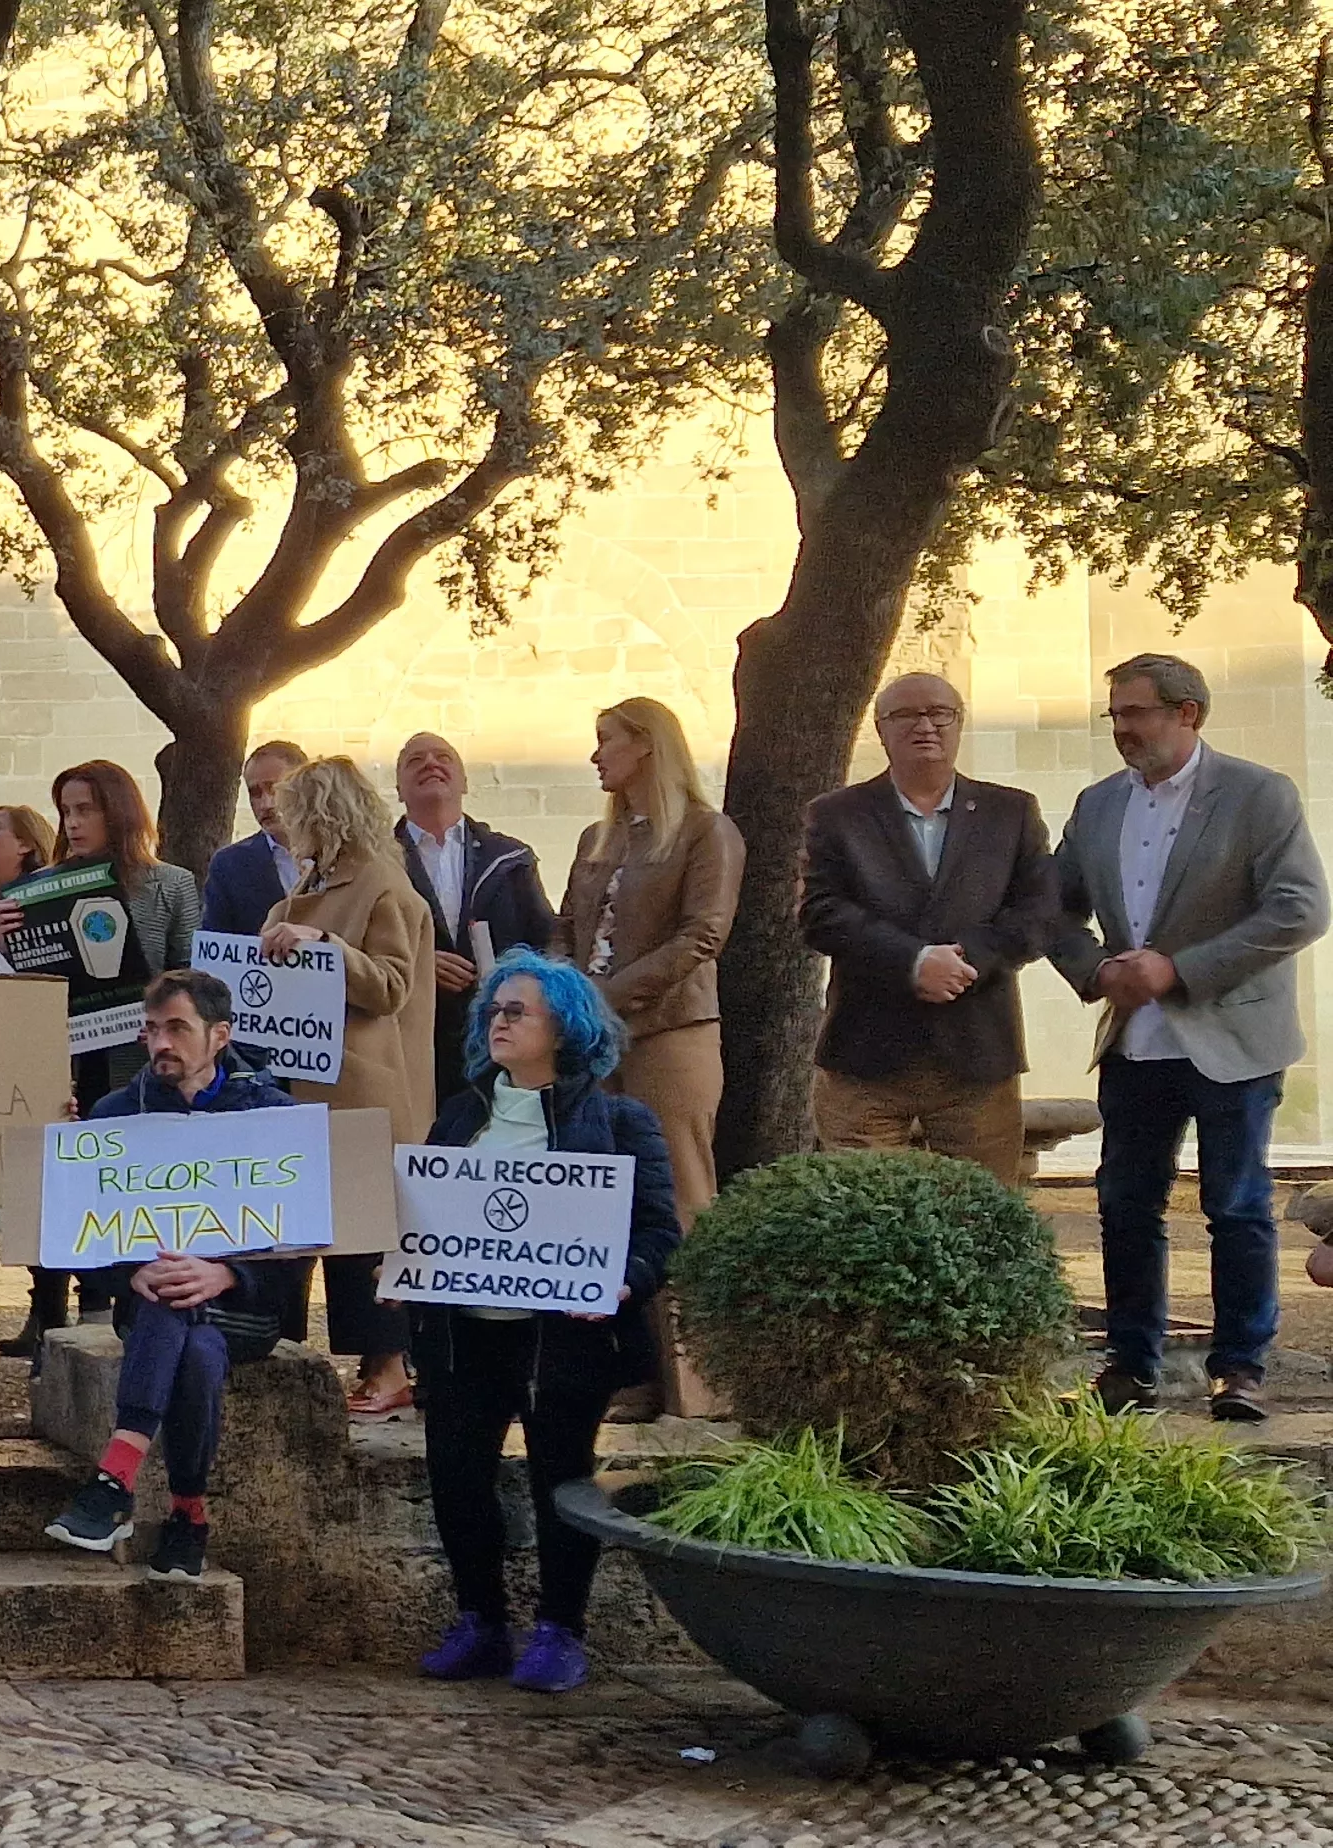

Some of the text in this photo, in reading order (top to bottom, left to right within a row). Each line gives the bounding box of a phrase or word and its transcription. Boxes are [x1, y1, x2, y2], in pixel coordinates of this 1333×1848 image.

[198, 939, 220, 961] NO
[222, 943, 242, 964] AL
[55, 1130, 125, 1161] LOS
[97, 1154, 305, 1194] RECORTES
[407, 1155, 617, 1190] NO AL RECORTE
[73, 1203, 282, 1256] MATAN
[399, 1232, 609, 1269] COOPERACIÓN
[393, 1266, 603, 1303] AL DESARROLLO
